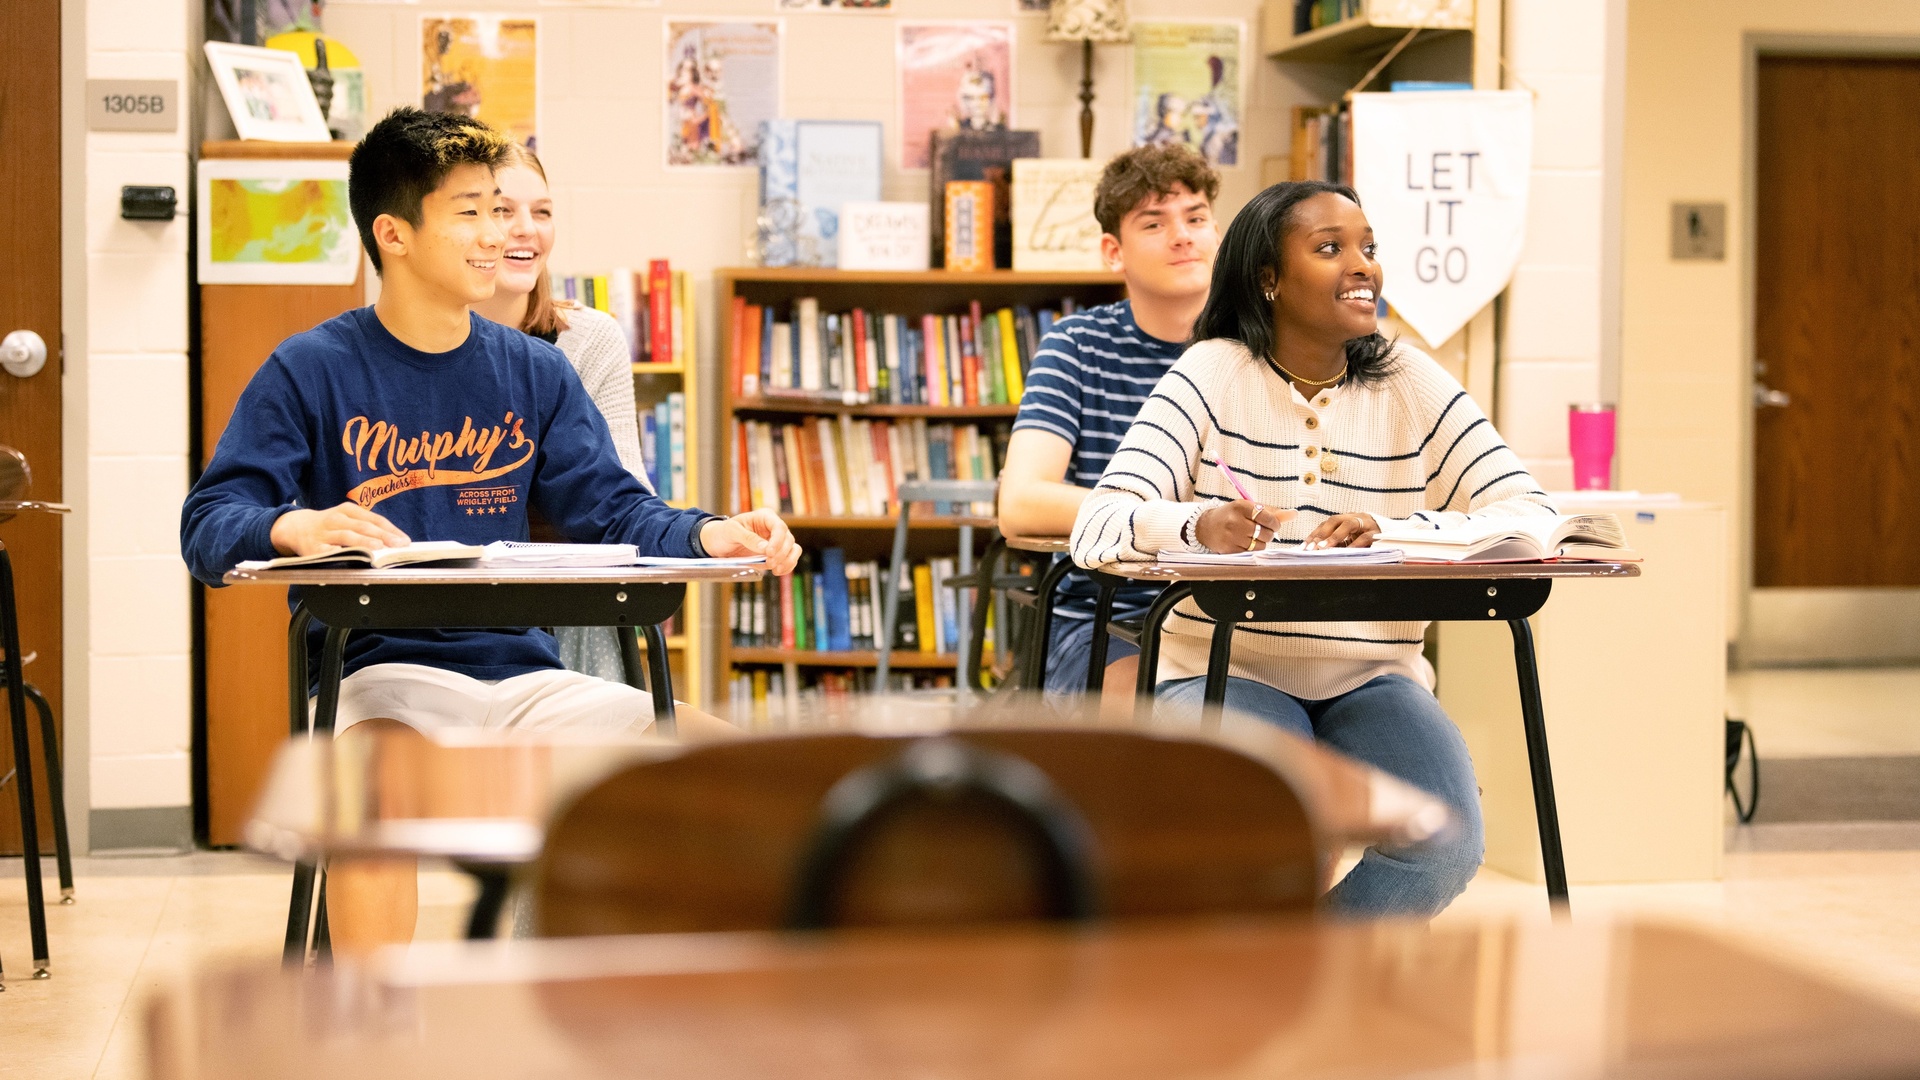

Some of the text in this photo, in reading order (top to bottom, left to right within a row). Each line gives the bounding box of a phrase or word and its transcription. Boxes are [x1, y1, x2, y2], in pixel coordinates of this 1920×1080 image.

[103, 95, 164, 114] 1305B
[1406, 151, 1482, 191] LET
[1423, 200, 1463, 237] IT
[1414, 246, 1468, 284] GO
[342, 411, 527, 480] Murphy's
[457, 496, 518, 506] WRIGLEY FIELD
[459, 488, 515, 498] ACROSS FROM
